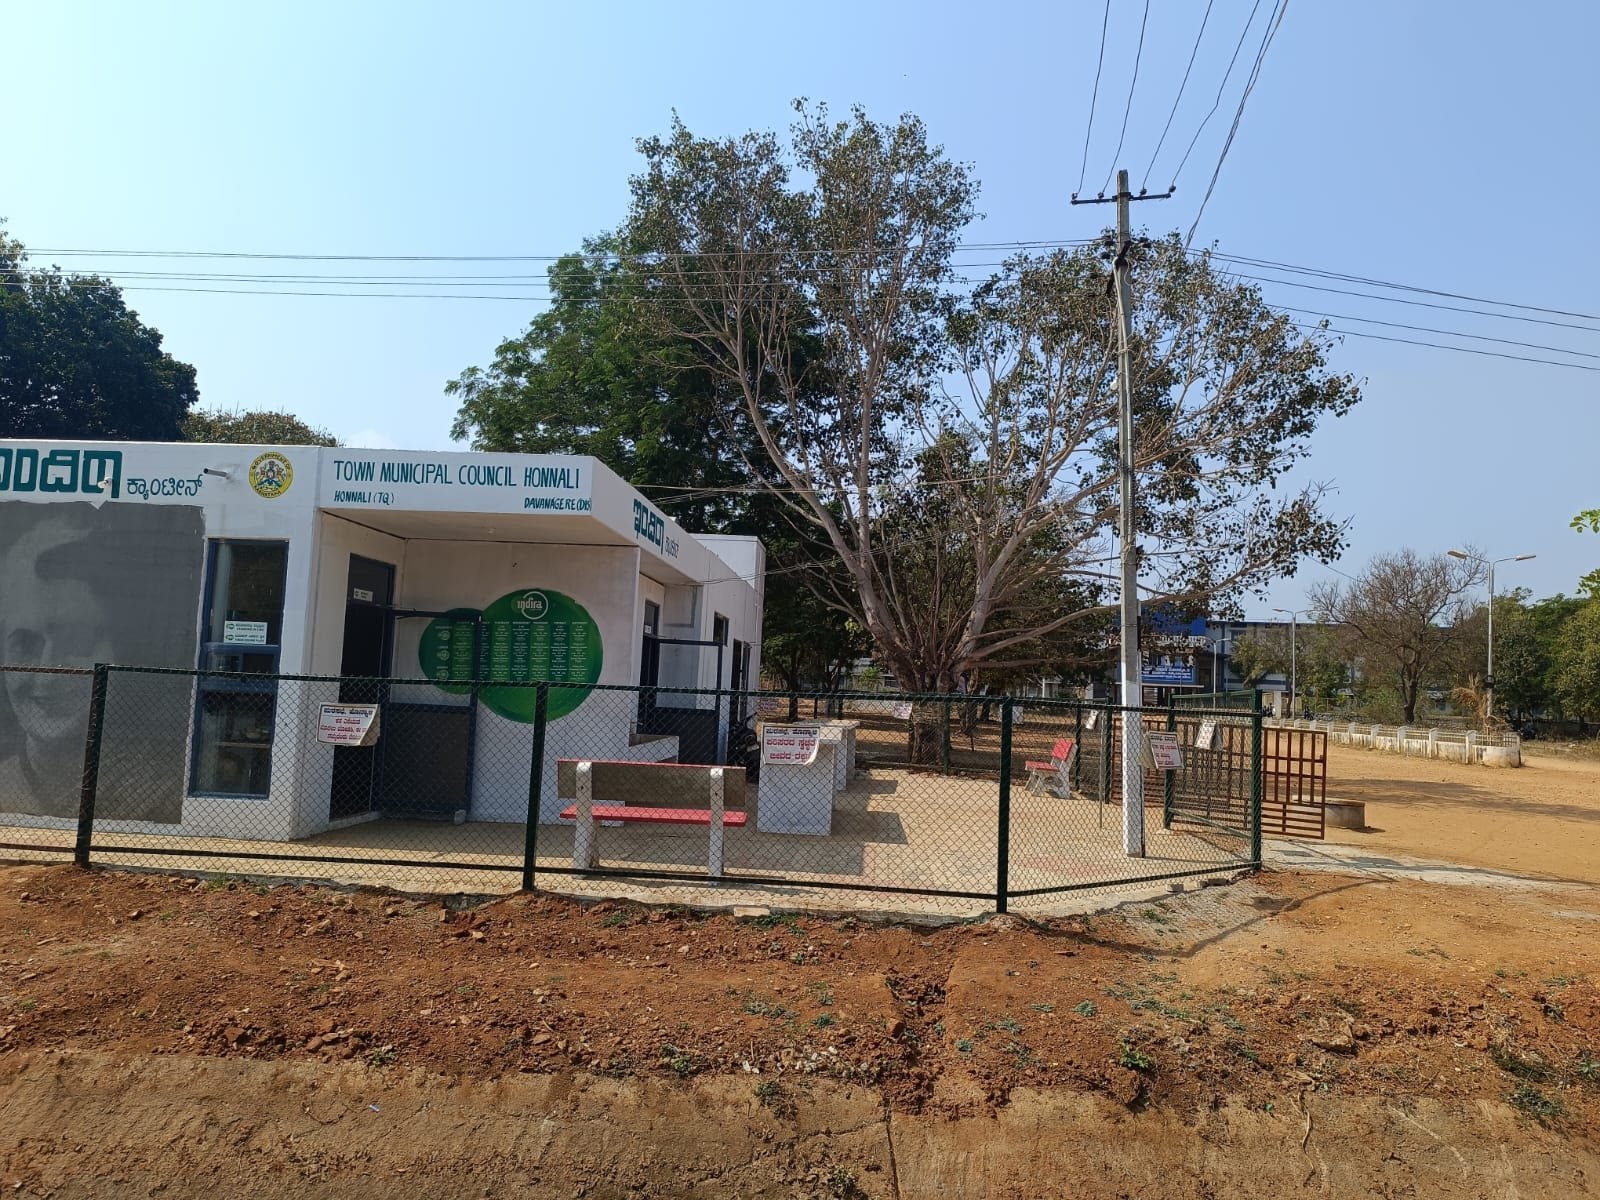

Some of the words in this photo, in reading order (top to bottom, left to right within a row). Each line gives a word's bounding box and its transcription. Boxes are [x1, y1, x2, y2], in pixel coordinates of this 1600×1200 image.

[0, 448, 123, 499] ಂದಿರಾ
[333, 460, 376, 482] TOWN
[379, 462, 453, 486] MUNICIPAL
[458, 464, 517, 488] COUNCIL
[523, 466, 580, 490] HONNALI
[333, 490, 372, 504] HONNALI
